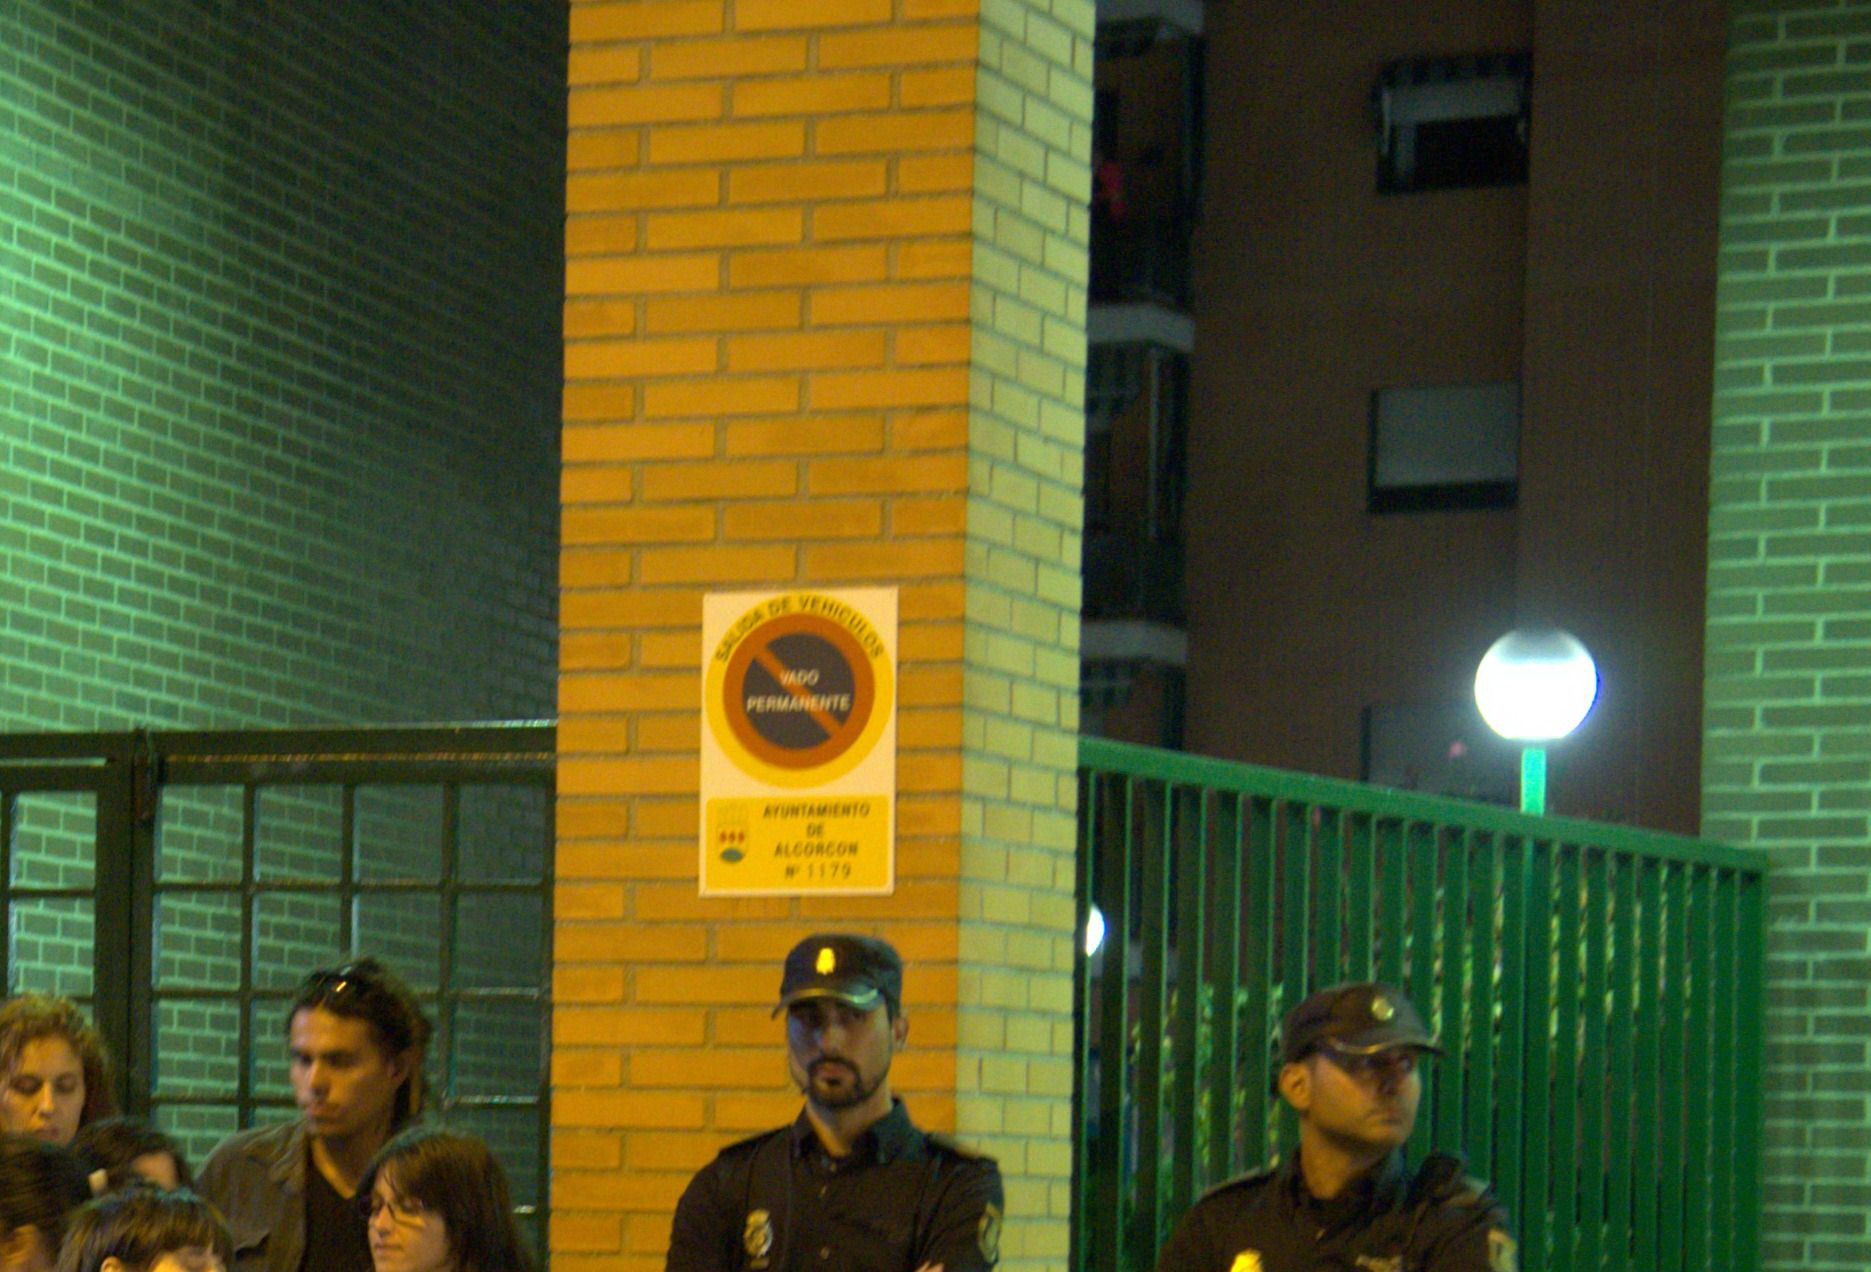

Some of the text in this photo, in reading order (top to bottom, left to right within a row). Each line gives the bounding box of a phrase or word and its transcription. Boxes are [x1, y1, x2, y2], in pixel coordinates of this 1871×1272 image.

[780, 668, 820, 686] VADO
[746, 693, 851, 713] PERMANENTE
[763, 802, 871, 819] AYUNTAMIENTO
[806, 822, 824, 838] DE
[774, 840, 859, 858] ALCORCON
